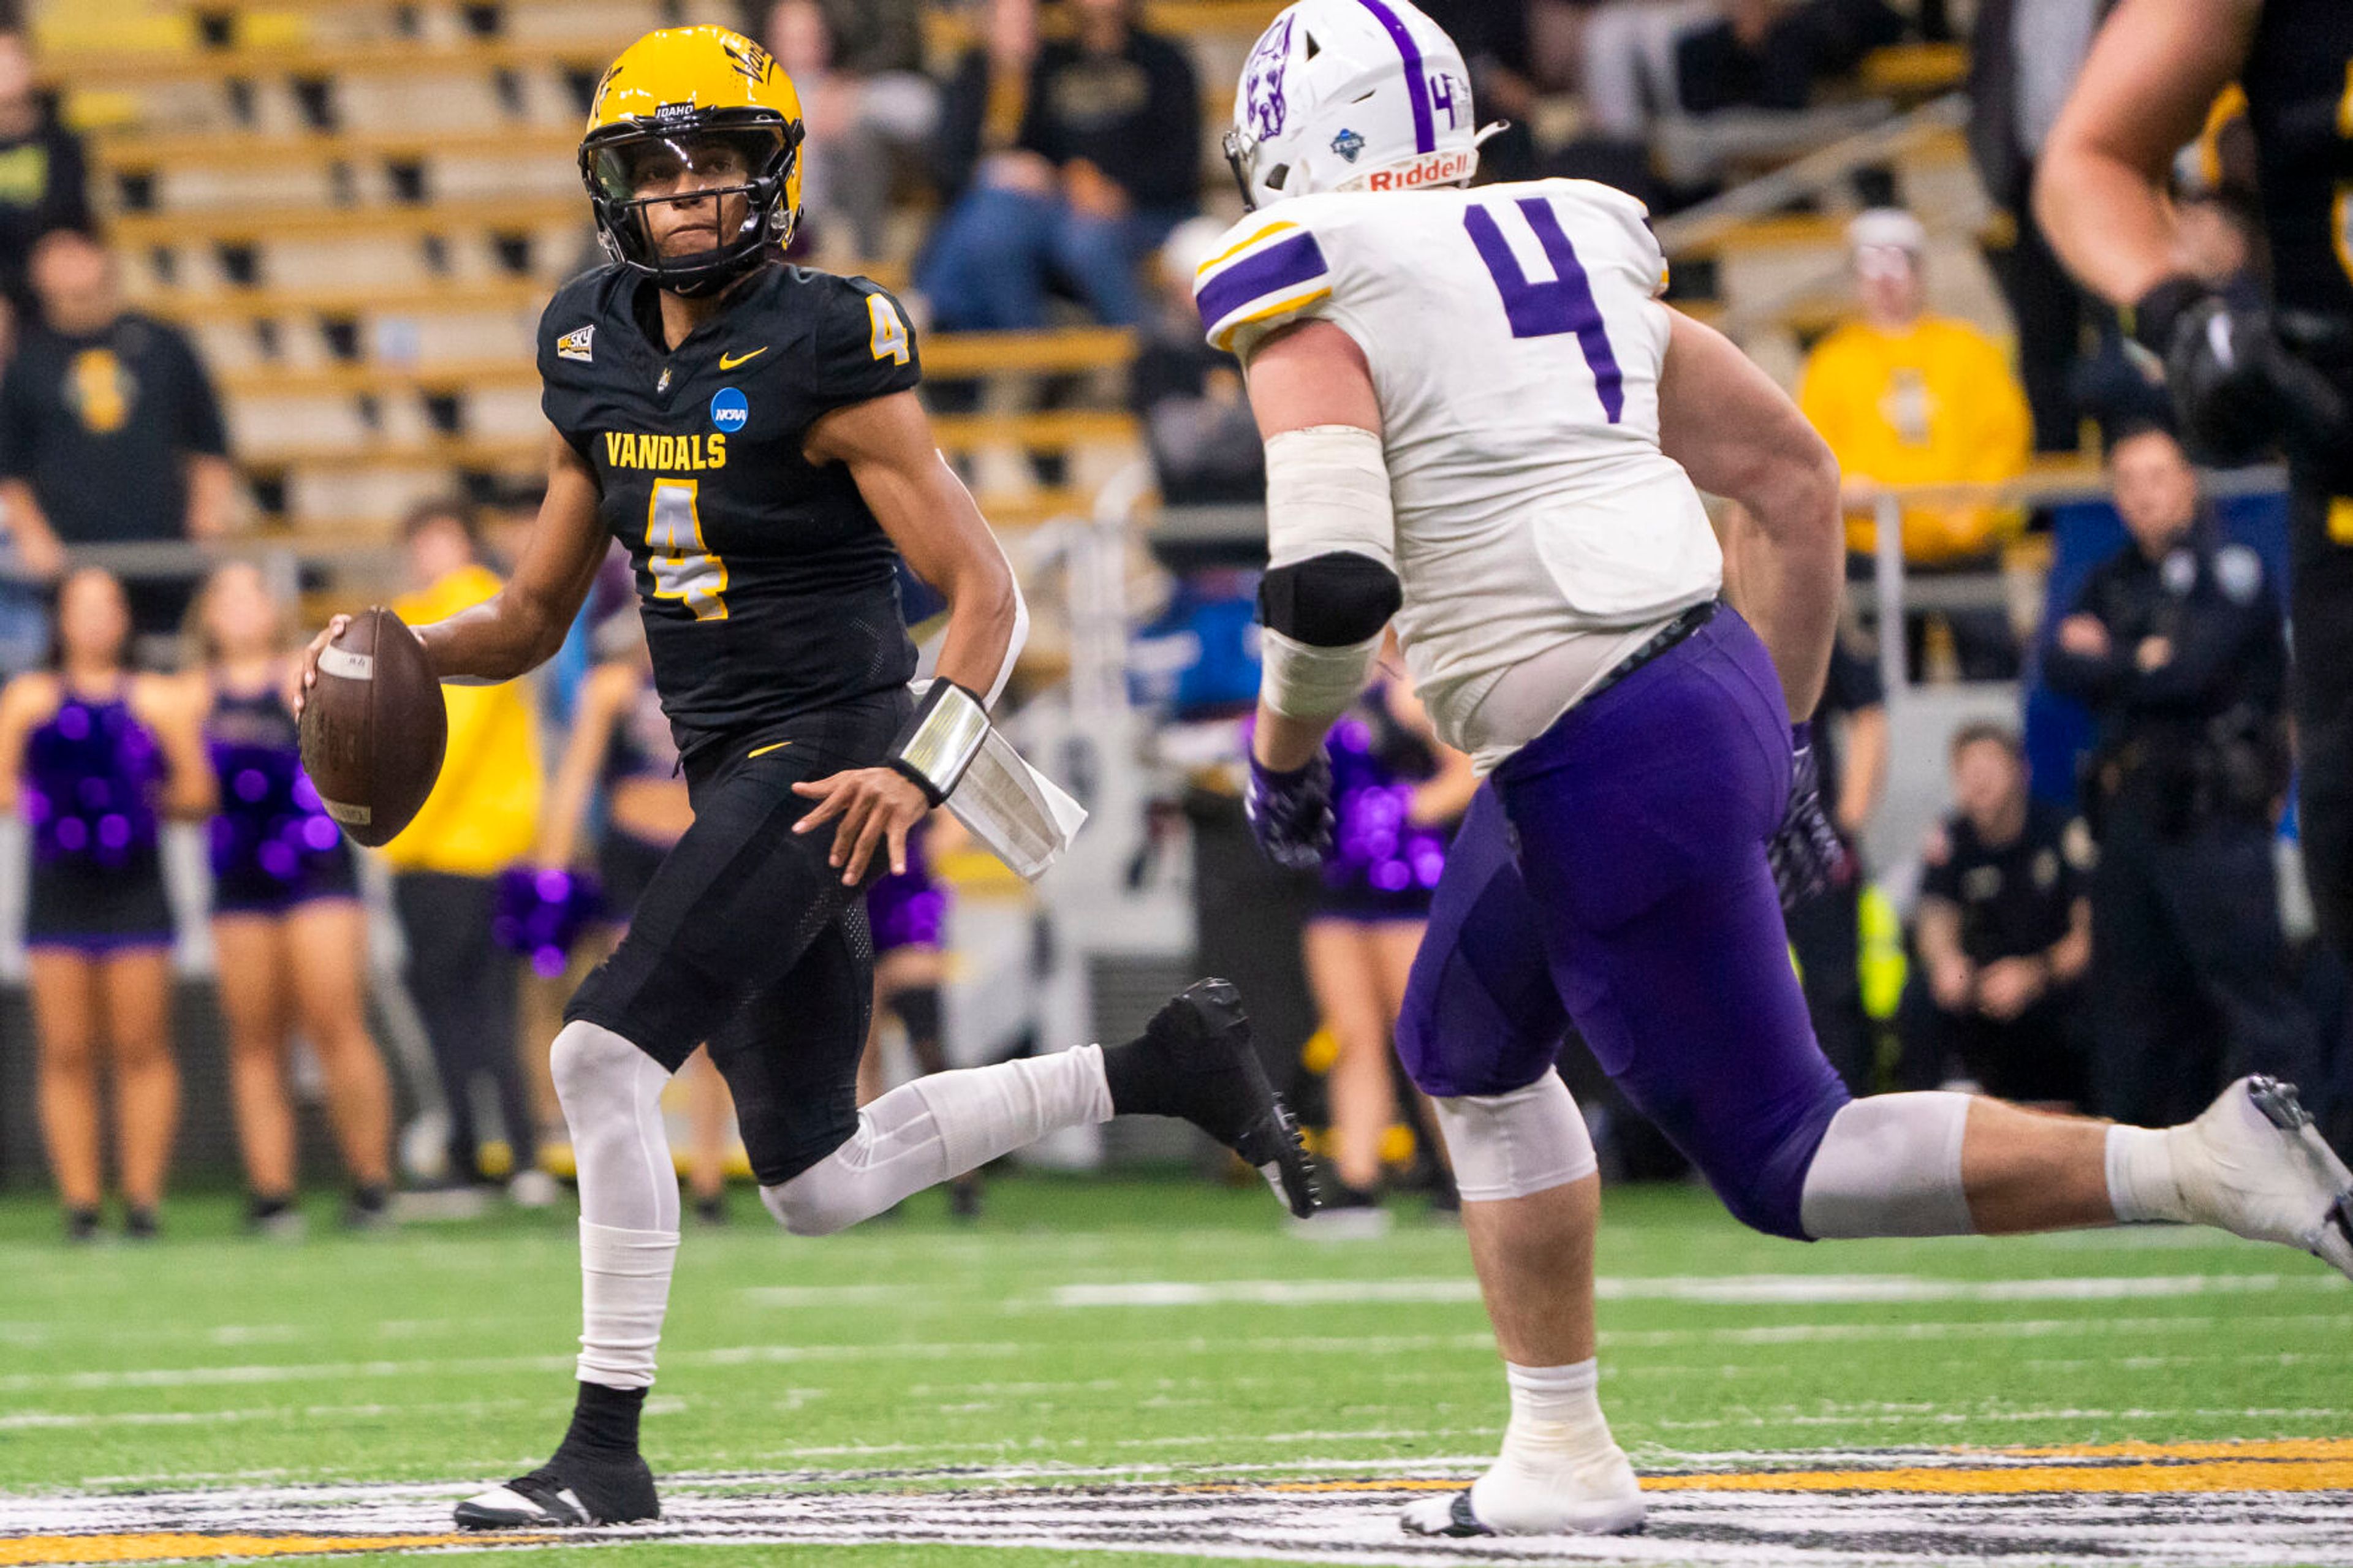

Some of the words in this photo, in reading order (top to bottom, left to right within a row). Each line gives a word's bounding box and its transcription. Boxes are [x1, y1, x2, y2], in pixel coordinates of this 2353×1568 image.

[656, 105, 694, 118] IDAHO
[1430, 73, 1455, 131] 4
[1370, 153, 1467, 192] Riddell
[866, 292, 910, 366] 4
[1463, 197, 1624, 424] 4
[716, 408, 747, 422] NCAA
[605, 432, 726, 471] VANDALS
[645, 477, 729, 622] 4
